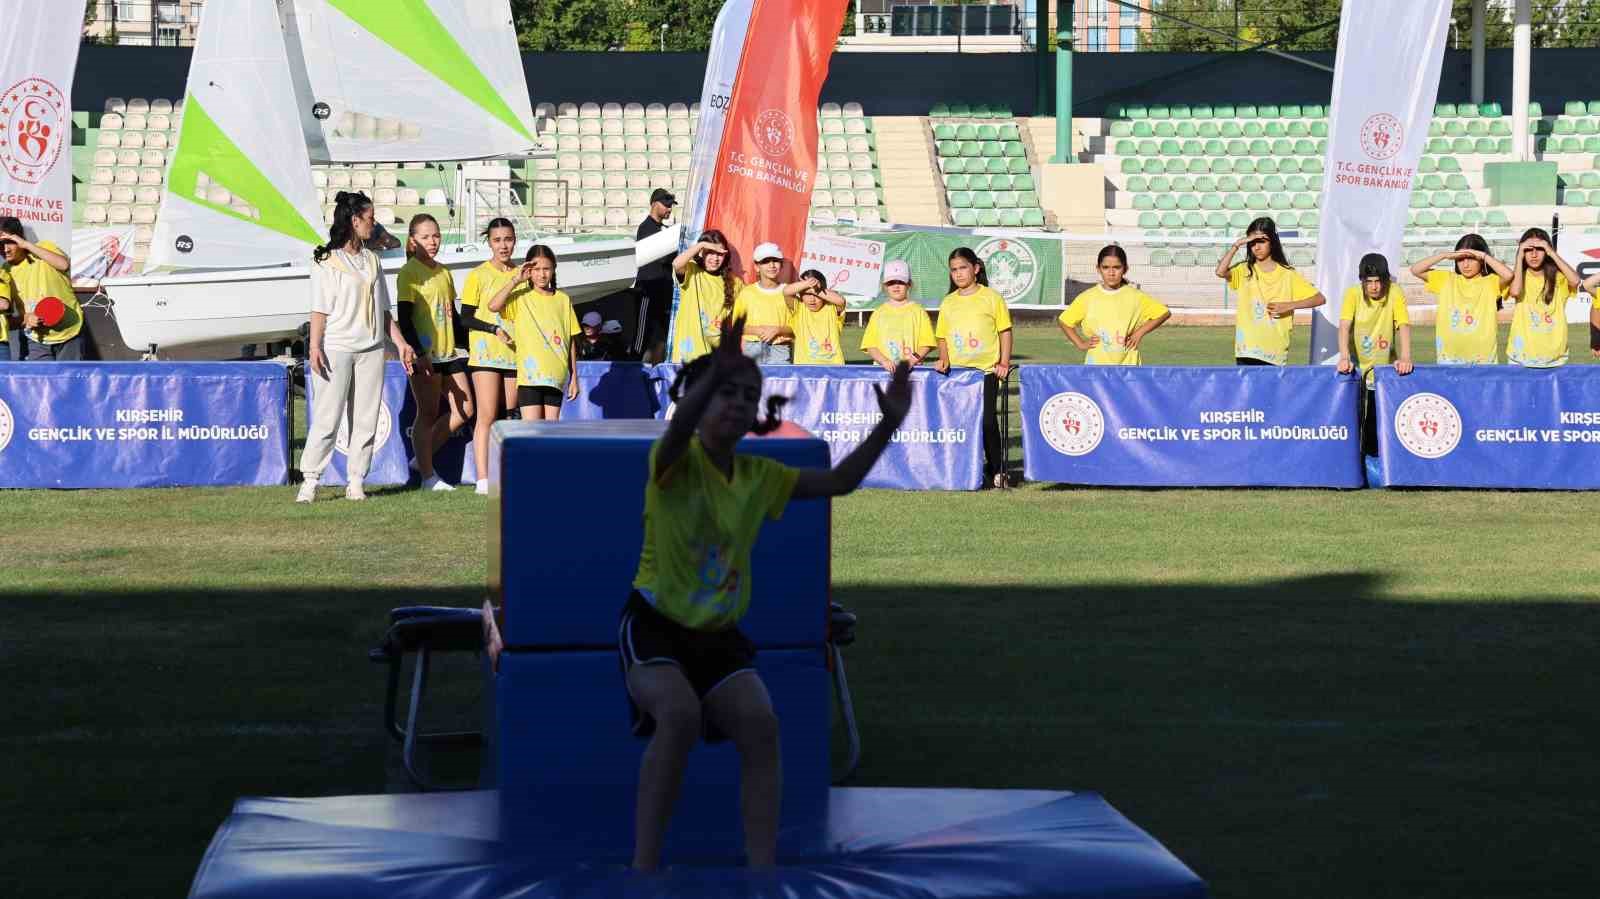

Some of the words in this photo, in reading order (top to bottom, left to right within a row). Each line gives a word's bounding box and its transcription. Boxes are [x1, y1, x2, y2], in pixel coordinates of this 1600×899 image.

[728, 163, 753, 177] SPOR
[795, 170, 809, 181] VE
[1335, 174, 1360, 185] SPOR
[47, 200, 63, 209] VE
[116, 408, 183, 424] KIRŞEHİR
[1200, 408, 1264, 424] KIRŞEHİR
[28, 426, 92, 442] GENÇLİK
[96, 428, 115, 440] VE
[118, 428, 158, 440] SPOR
[161, 426, 174, 440] İL
[178, 425, 269, 441] MÜDÜRLÜĞÜ
[823, 430, 860, 442] SPOR
[888, 428, 966, 443] ÜDÜRLÜĞÜ
[1118, 426, 1179, 442] GENÇLİK
[1184, 428, 1199, 440] VE
[1203, 428, 1241, 440] SPOR
[1245, 426, 1257, 440] İL
[1261, 425, 1348, 441] MÜDÜRLÜĞÜ
[1476, 427, 1537, 443] GENÇLİK
[1540, 430, 1560, 442] VE
[1563, 430, 1600, 442] SPOR
